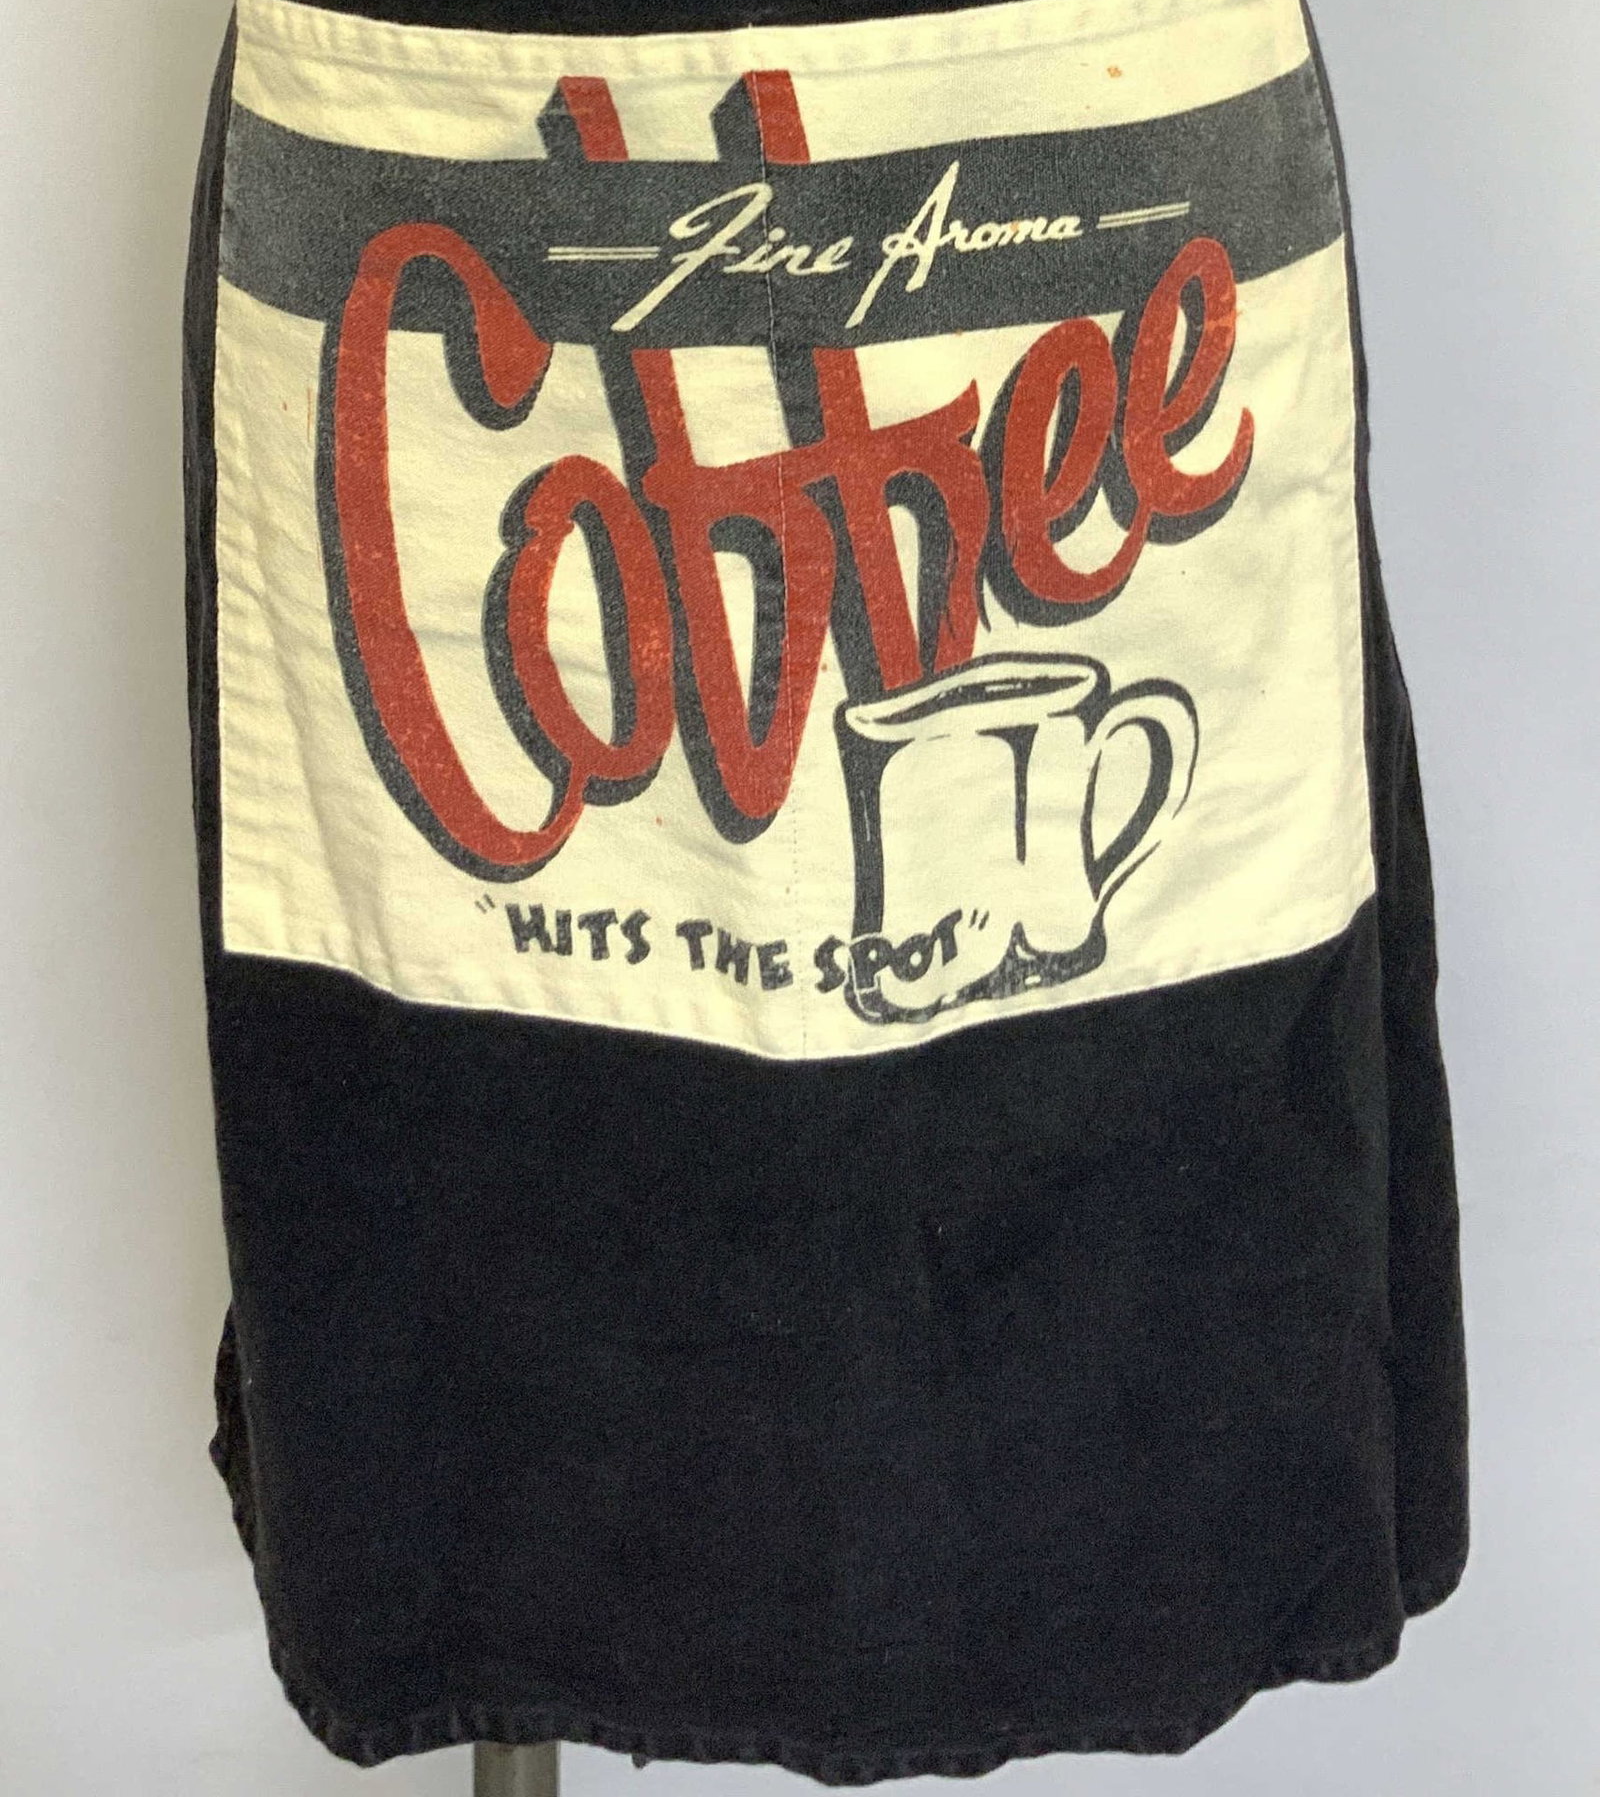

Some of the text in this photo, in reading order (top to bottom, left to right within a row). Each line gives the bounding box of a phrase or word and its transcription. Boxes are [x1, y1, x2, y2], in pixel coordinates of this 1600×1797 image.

[611, 160, 1083, 332] Fine Aroma
[316, 68, 1254, 883] Coffee
[675, 918, 794, 992] THE
